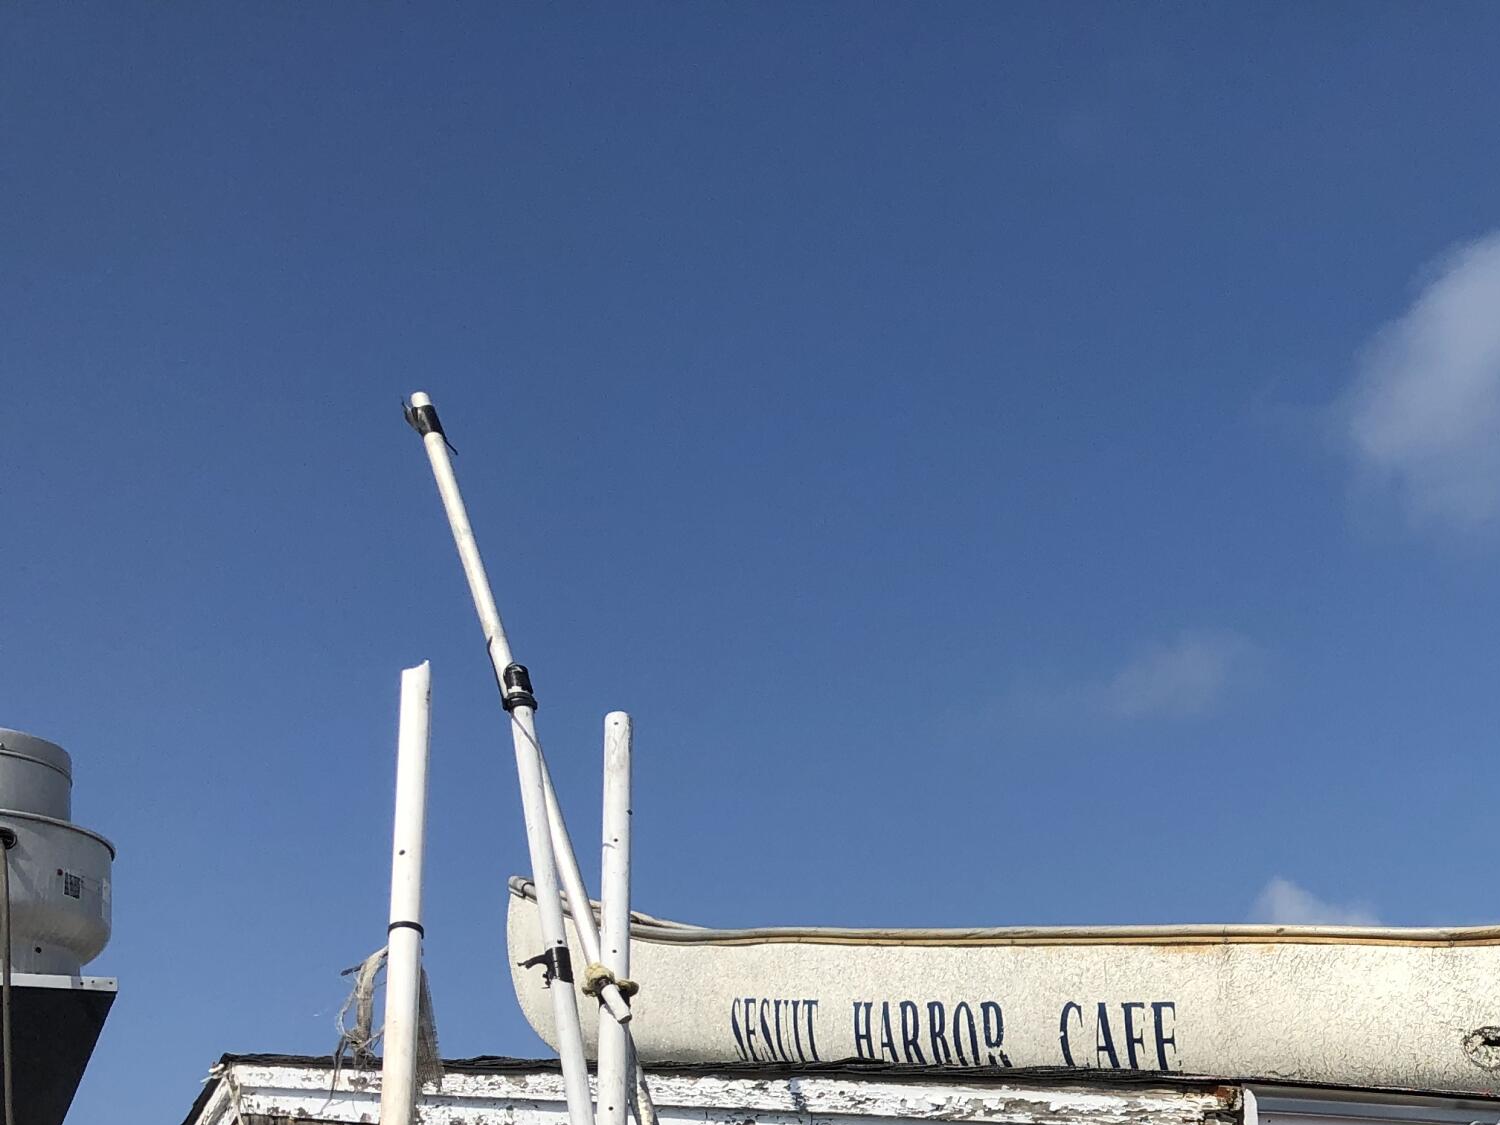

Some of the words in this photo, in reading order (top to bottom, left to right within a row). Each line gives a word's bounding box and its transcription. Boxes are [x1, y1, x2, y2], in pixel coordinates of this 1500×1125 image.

[731, 997, 820, 1062] SESUIT
[853, 1000, 1013, 1068] HARBOR
[1059, 1001, 1181, 1071] CAFE
